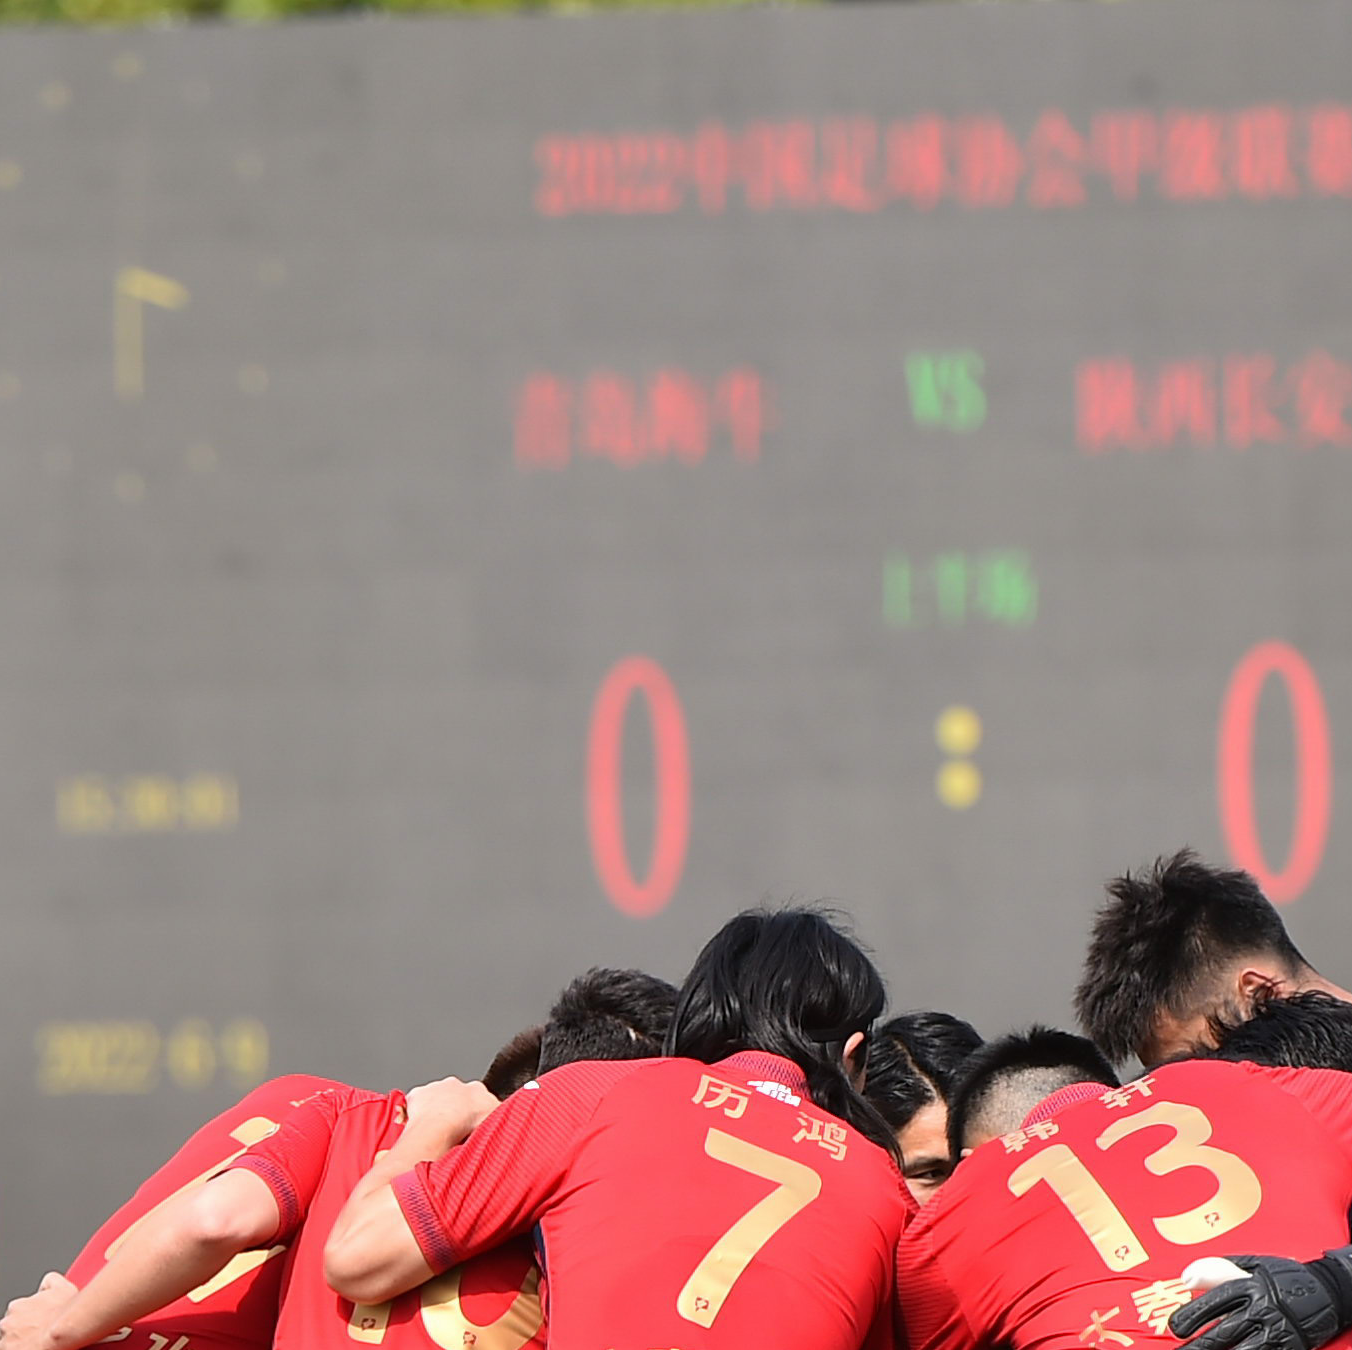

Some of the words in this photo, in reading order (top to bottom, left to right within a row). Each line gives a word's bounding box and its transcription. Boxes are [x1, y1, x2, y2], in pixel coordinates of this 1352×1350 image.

[585, 656, 690, 918] 0
[1218, 640, 1331, 904] 0
[676, 1127, 822, 1329] 7
[1007, 1100, 1263, 1273] 13
